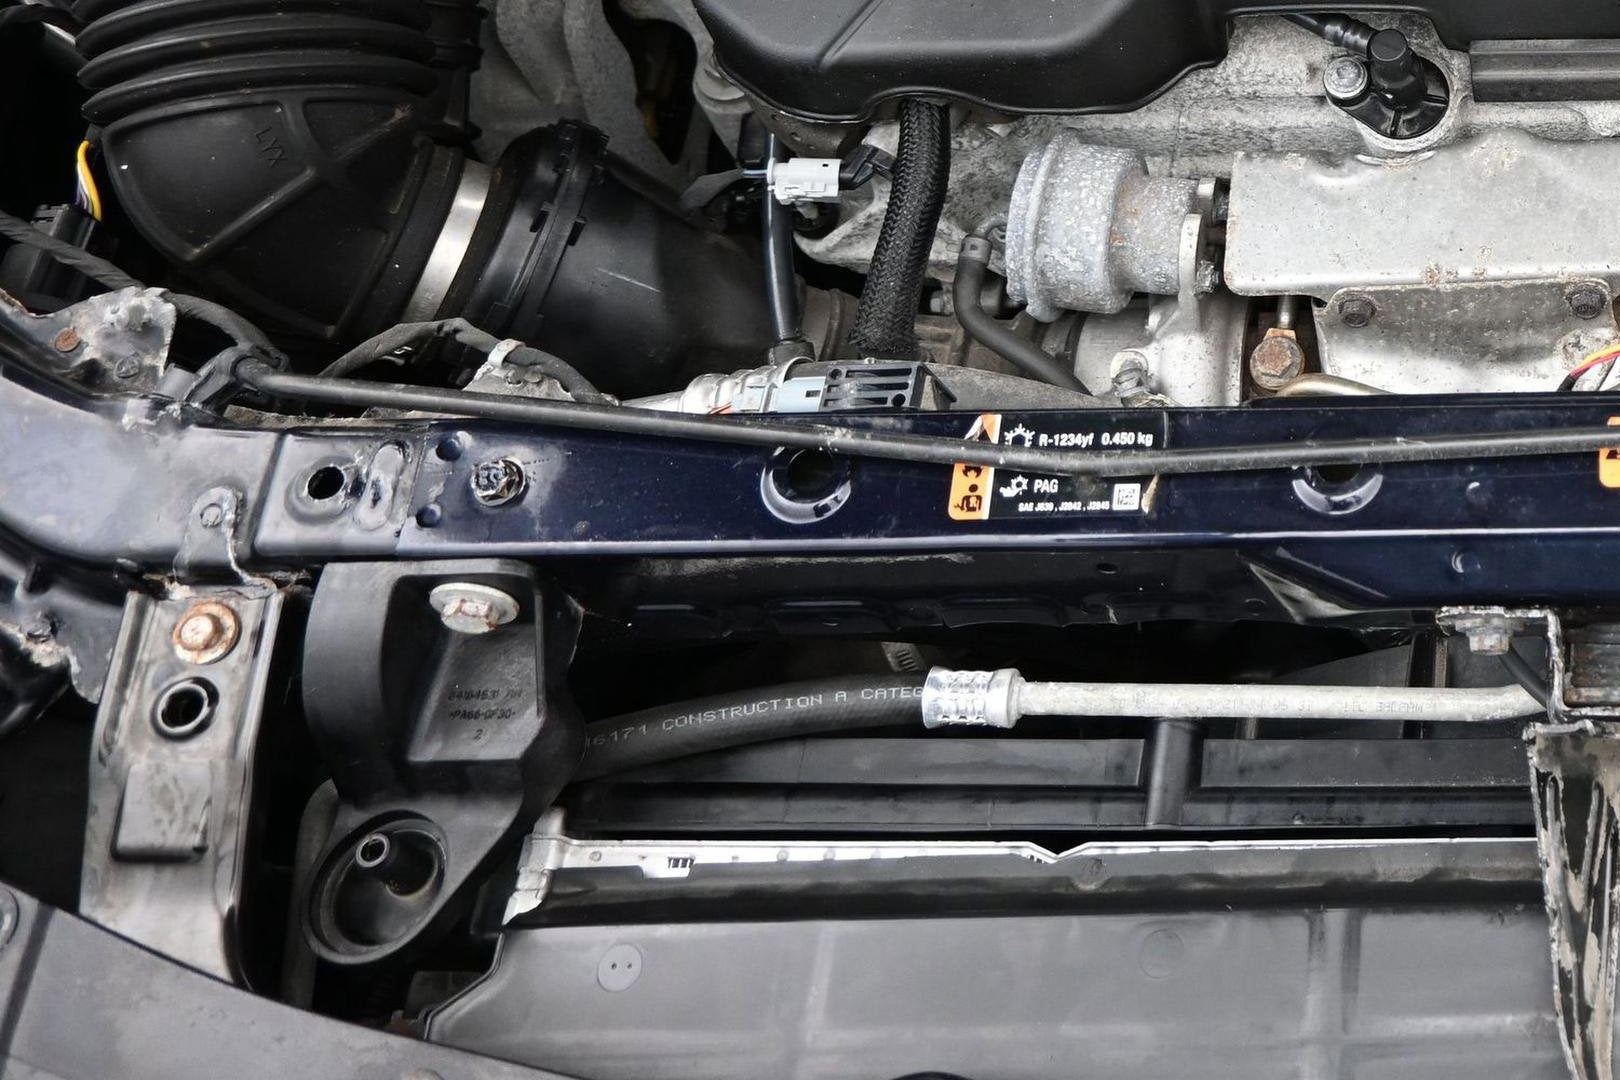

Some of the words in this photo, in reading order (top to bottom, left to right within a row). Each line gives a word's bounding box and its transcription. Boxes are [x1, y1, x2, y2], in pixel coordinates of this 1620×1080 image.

[1039, 432, 1094, 448] R-1234yf
[1101, 432, 1137, 445] 0.450
[1137, 432, 1153, 447] kg
[1034, 479, 1058, 493] PAG
[662, 694, 823, 731] CONSTRUCTION
[835, 690, 847, 703] A
